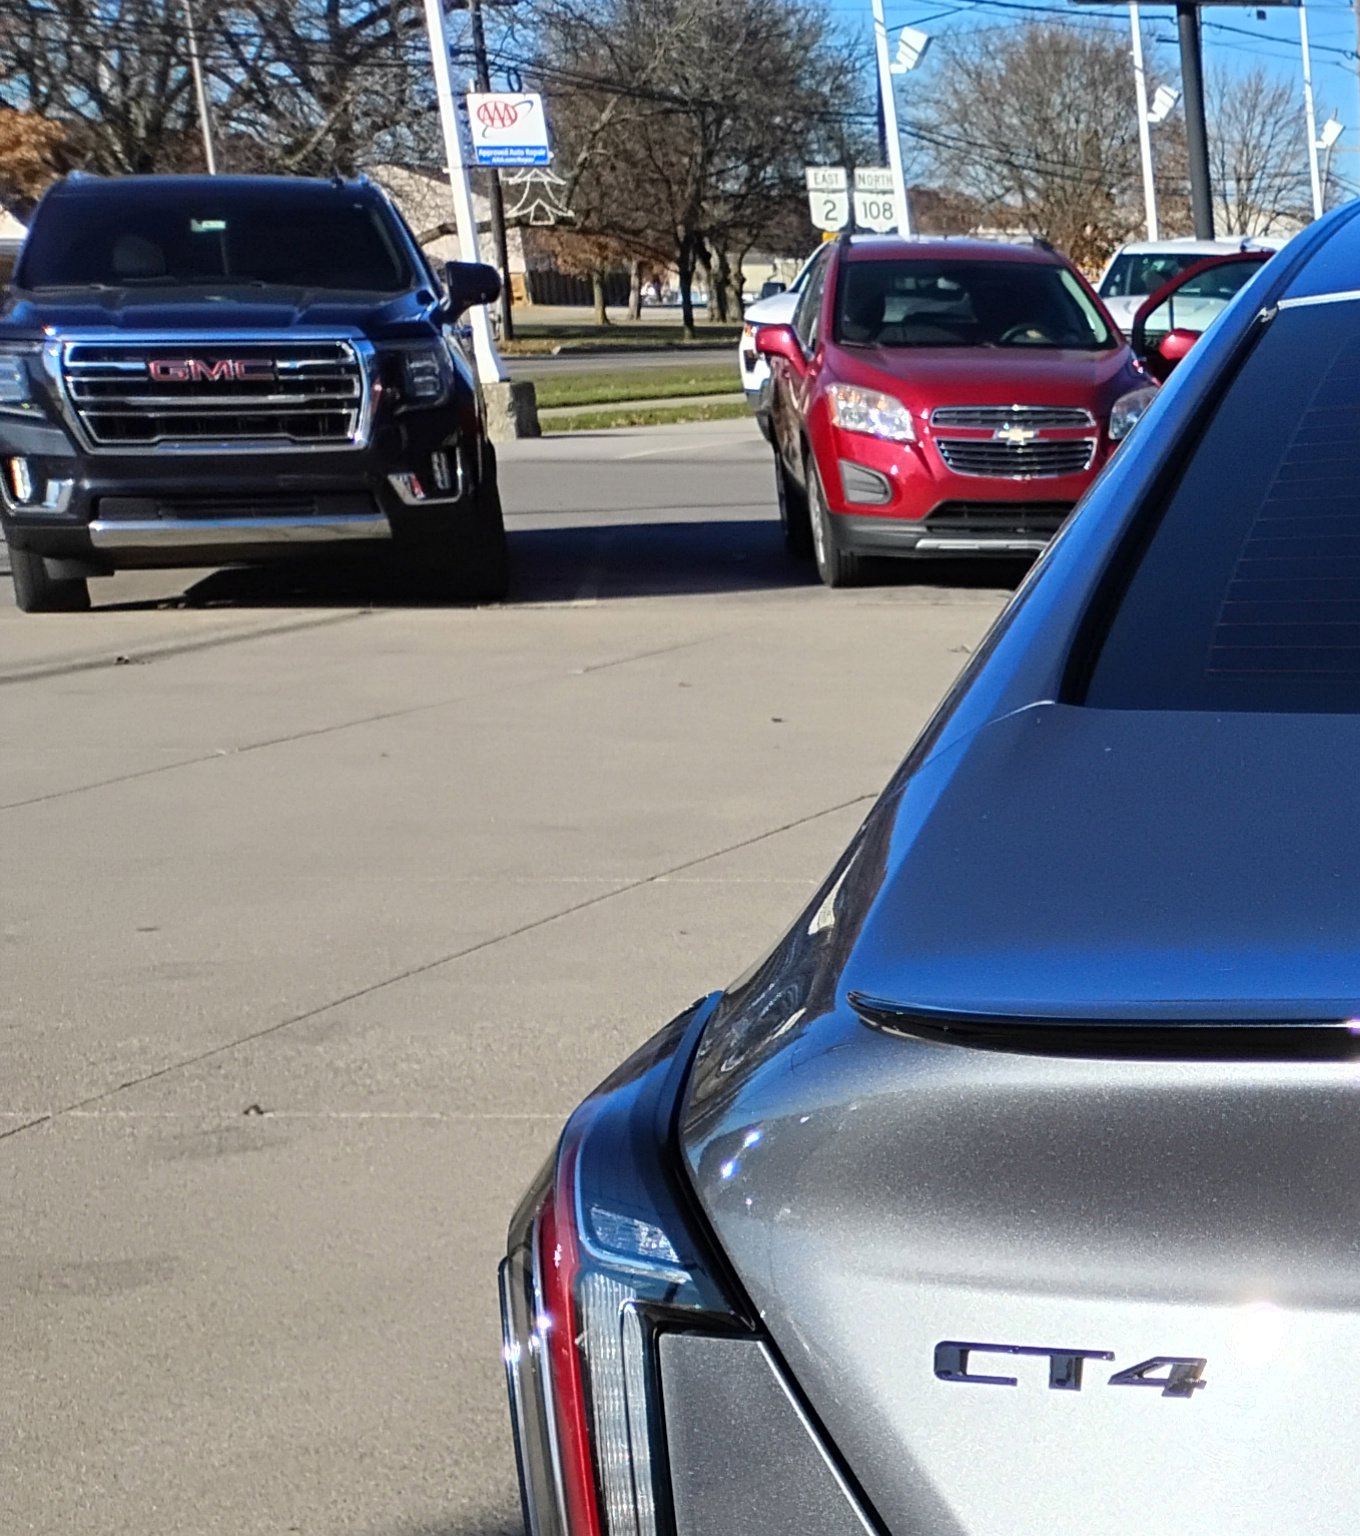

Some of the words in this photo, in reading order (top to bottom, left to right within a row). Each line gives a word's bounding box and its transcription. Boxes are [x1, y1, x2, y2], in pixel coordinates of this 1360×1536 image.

[479, 101, 517, 128] AAA
[813, 172, 839, 185] EAST
[857, 174, 893, 186] NORTH
[823, 200, 838, 221] 2
[862, 201, 893, 220] 108
[149, 359, 275, 381] GMC
[934, 1340, 1207, 1399] CT4
